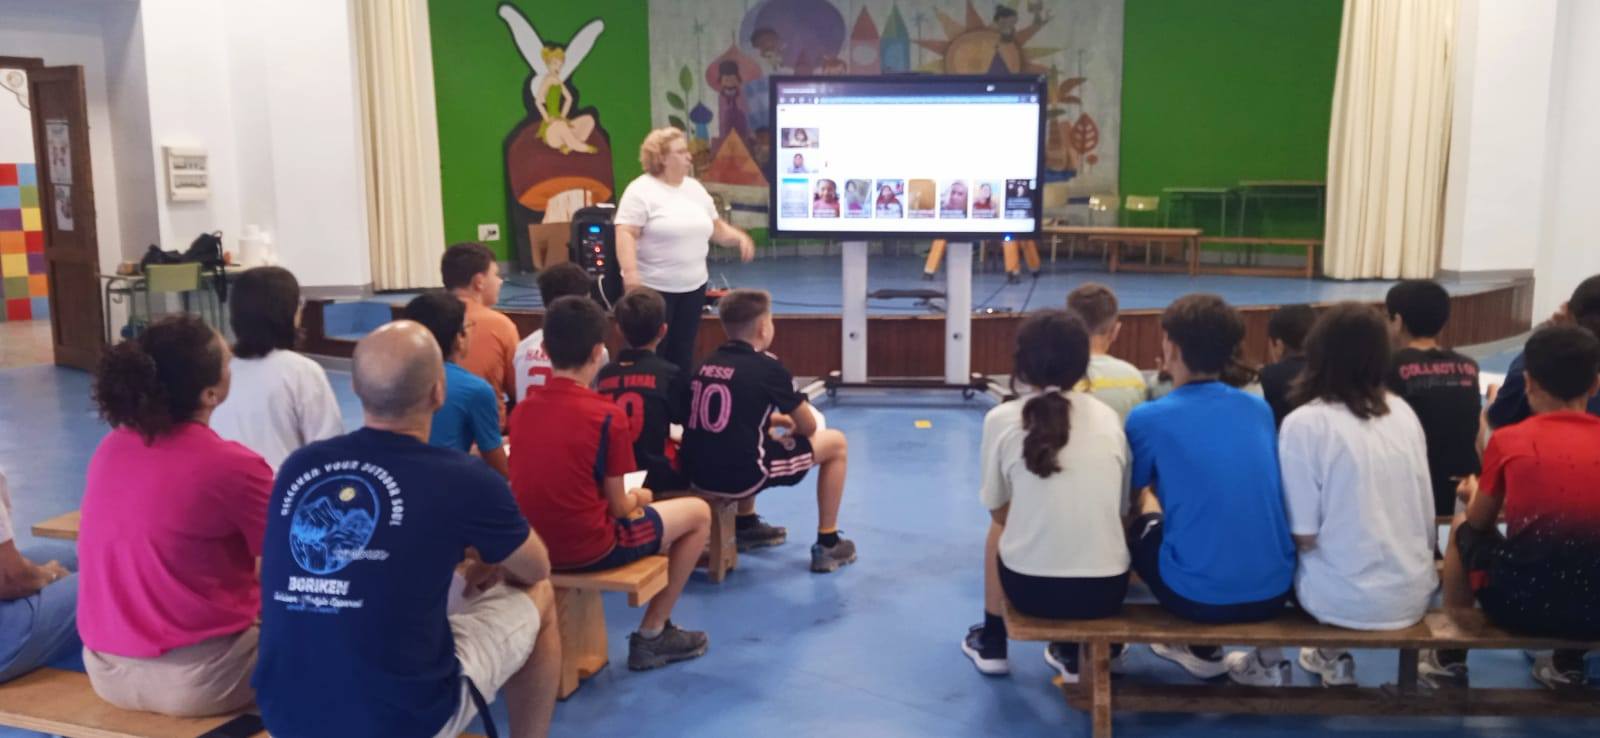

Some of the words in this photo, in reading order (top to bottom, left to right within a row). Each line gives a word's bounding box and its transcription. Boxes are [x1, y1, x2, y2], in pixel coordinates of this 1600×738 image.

[699, 364, 735, 380] MESSI
[688, 379, 732, 433] 10
[280, 467, 321, 516] DISCOVER
[324, 460, 360, 472] YOUR
[361, 462, 401, 497] OUTDOOR
[389, 498, 404, 525] SOUL
[288, 576, 350, 596] BORIKEN
